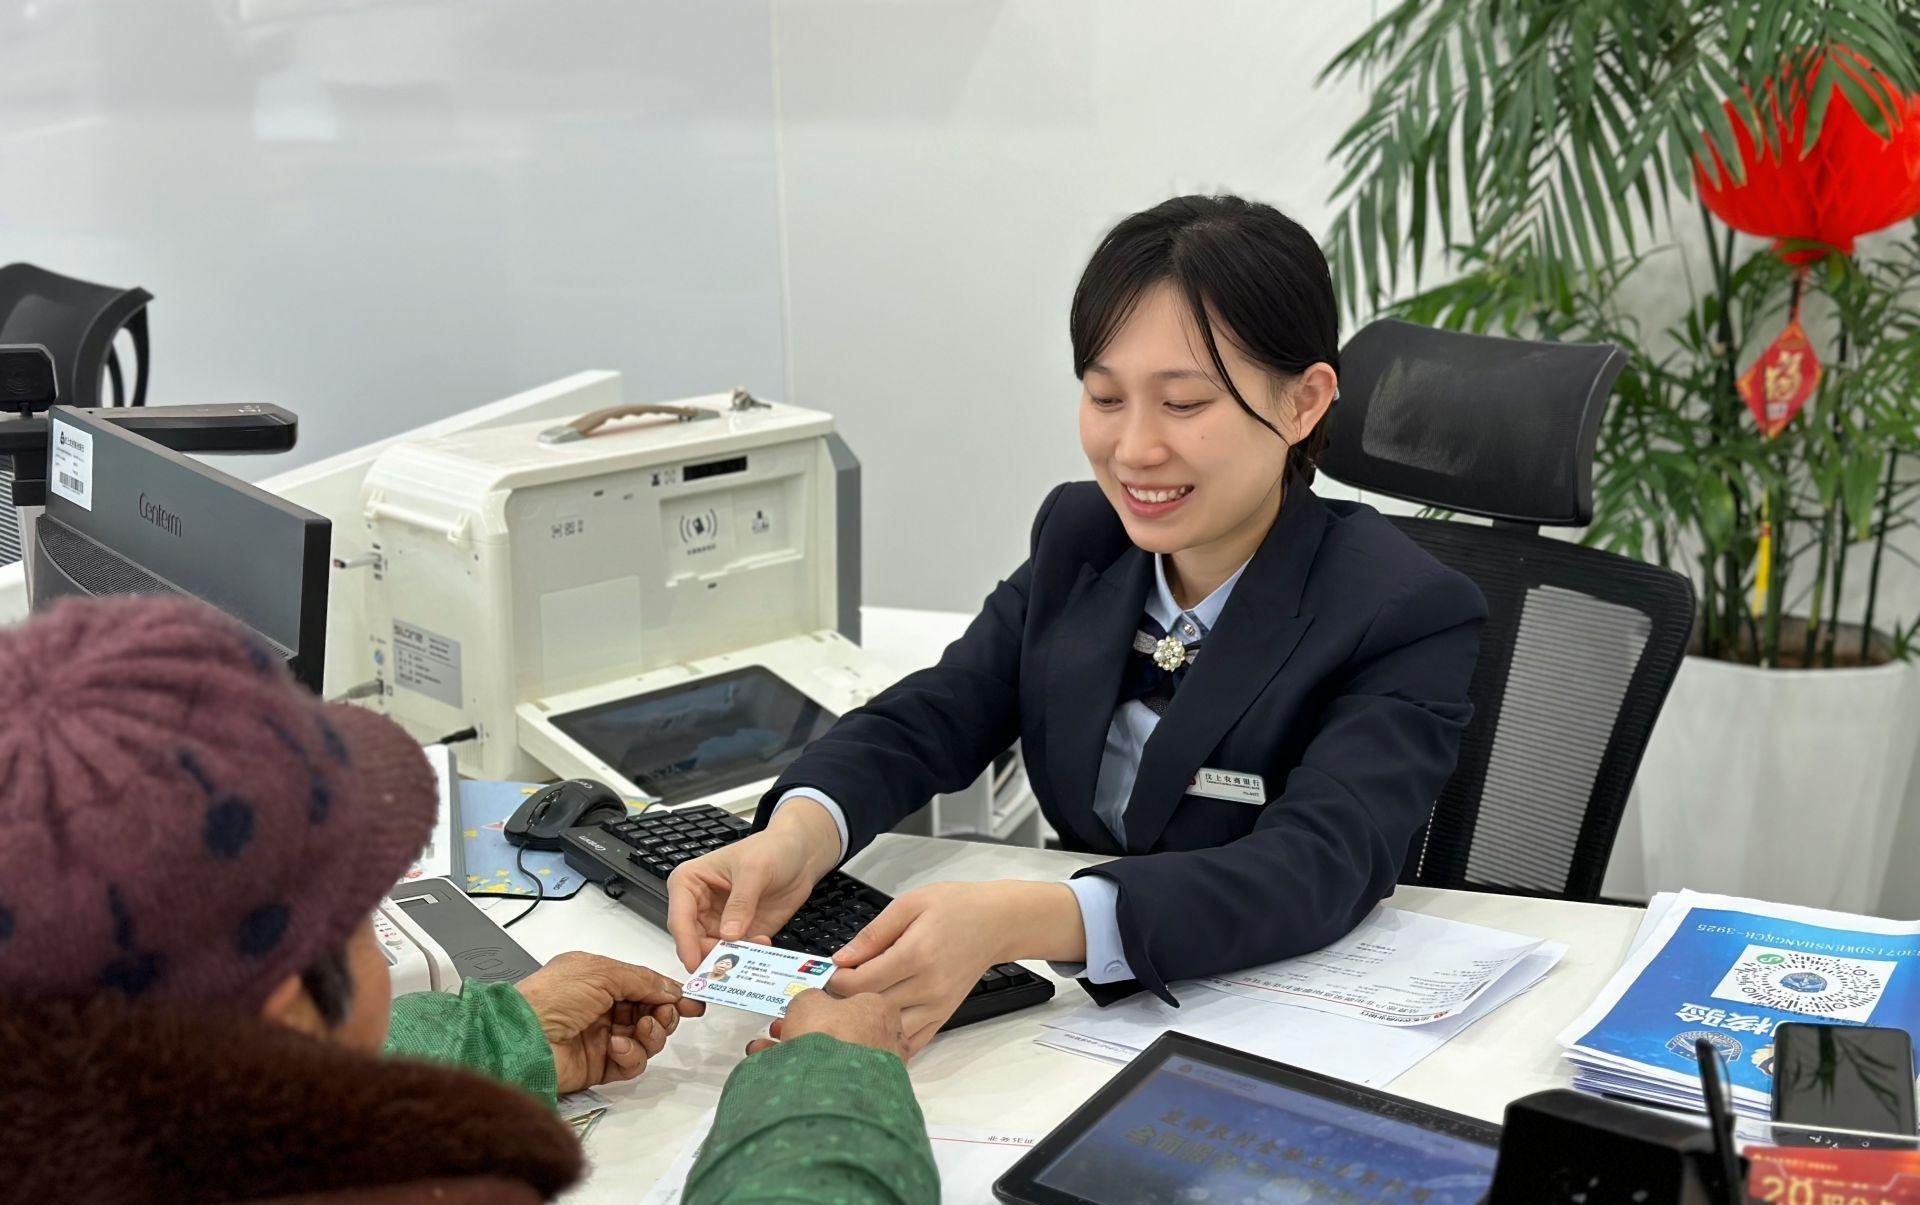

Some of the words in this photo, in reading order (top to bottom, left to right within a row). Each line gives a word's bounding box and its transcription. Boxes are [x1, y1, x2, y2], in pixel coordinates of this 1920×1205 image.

[139, 492, 182, 538] Centerm
[708, 983, 728, 993] 6223
[1674, 1002, 1776, 1037] 核验
